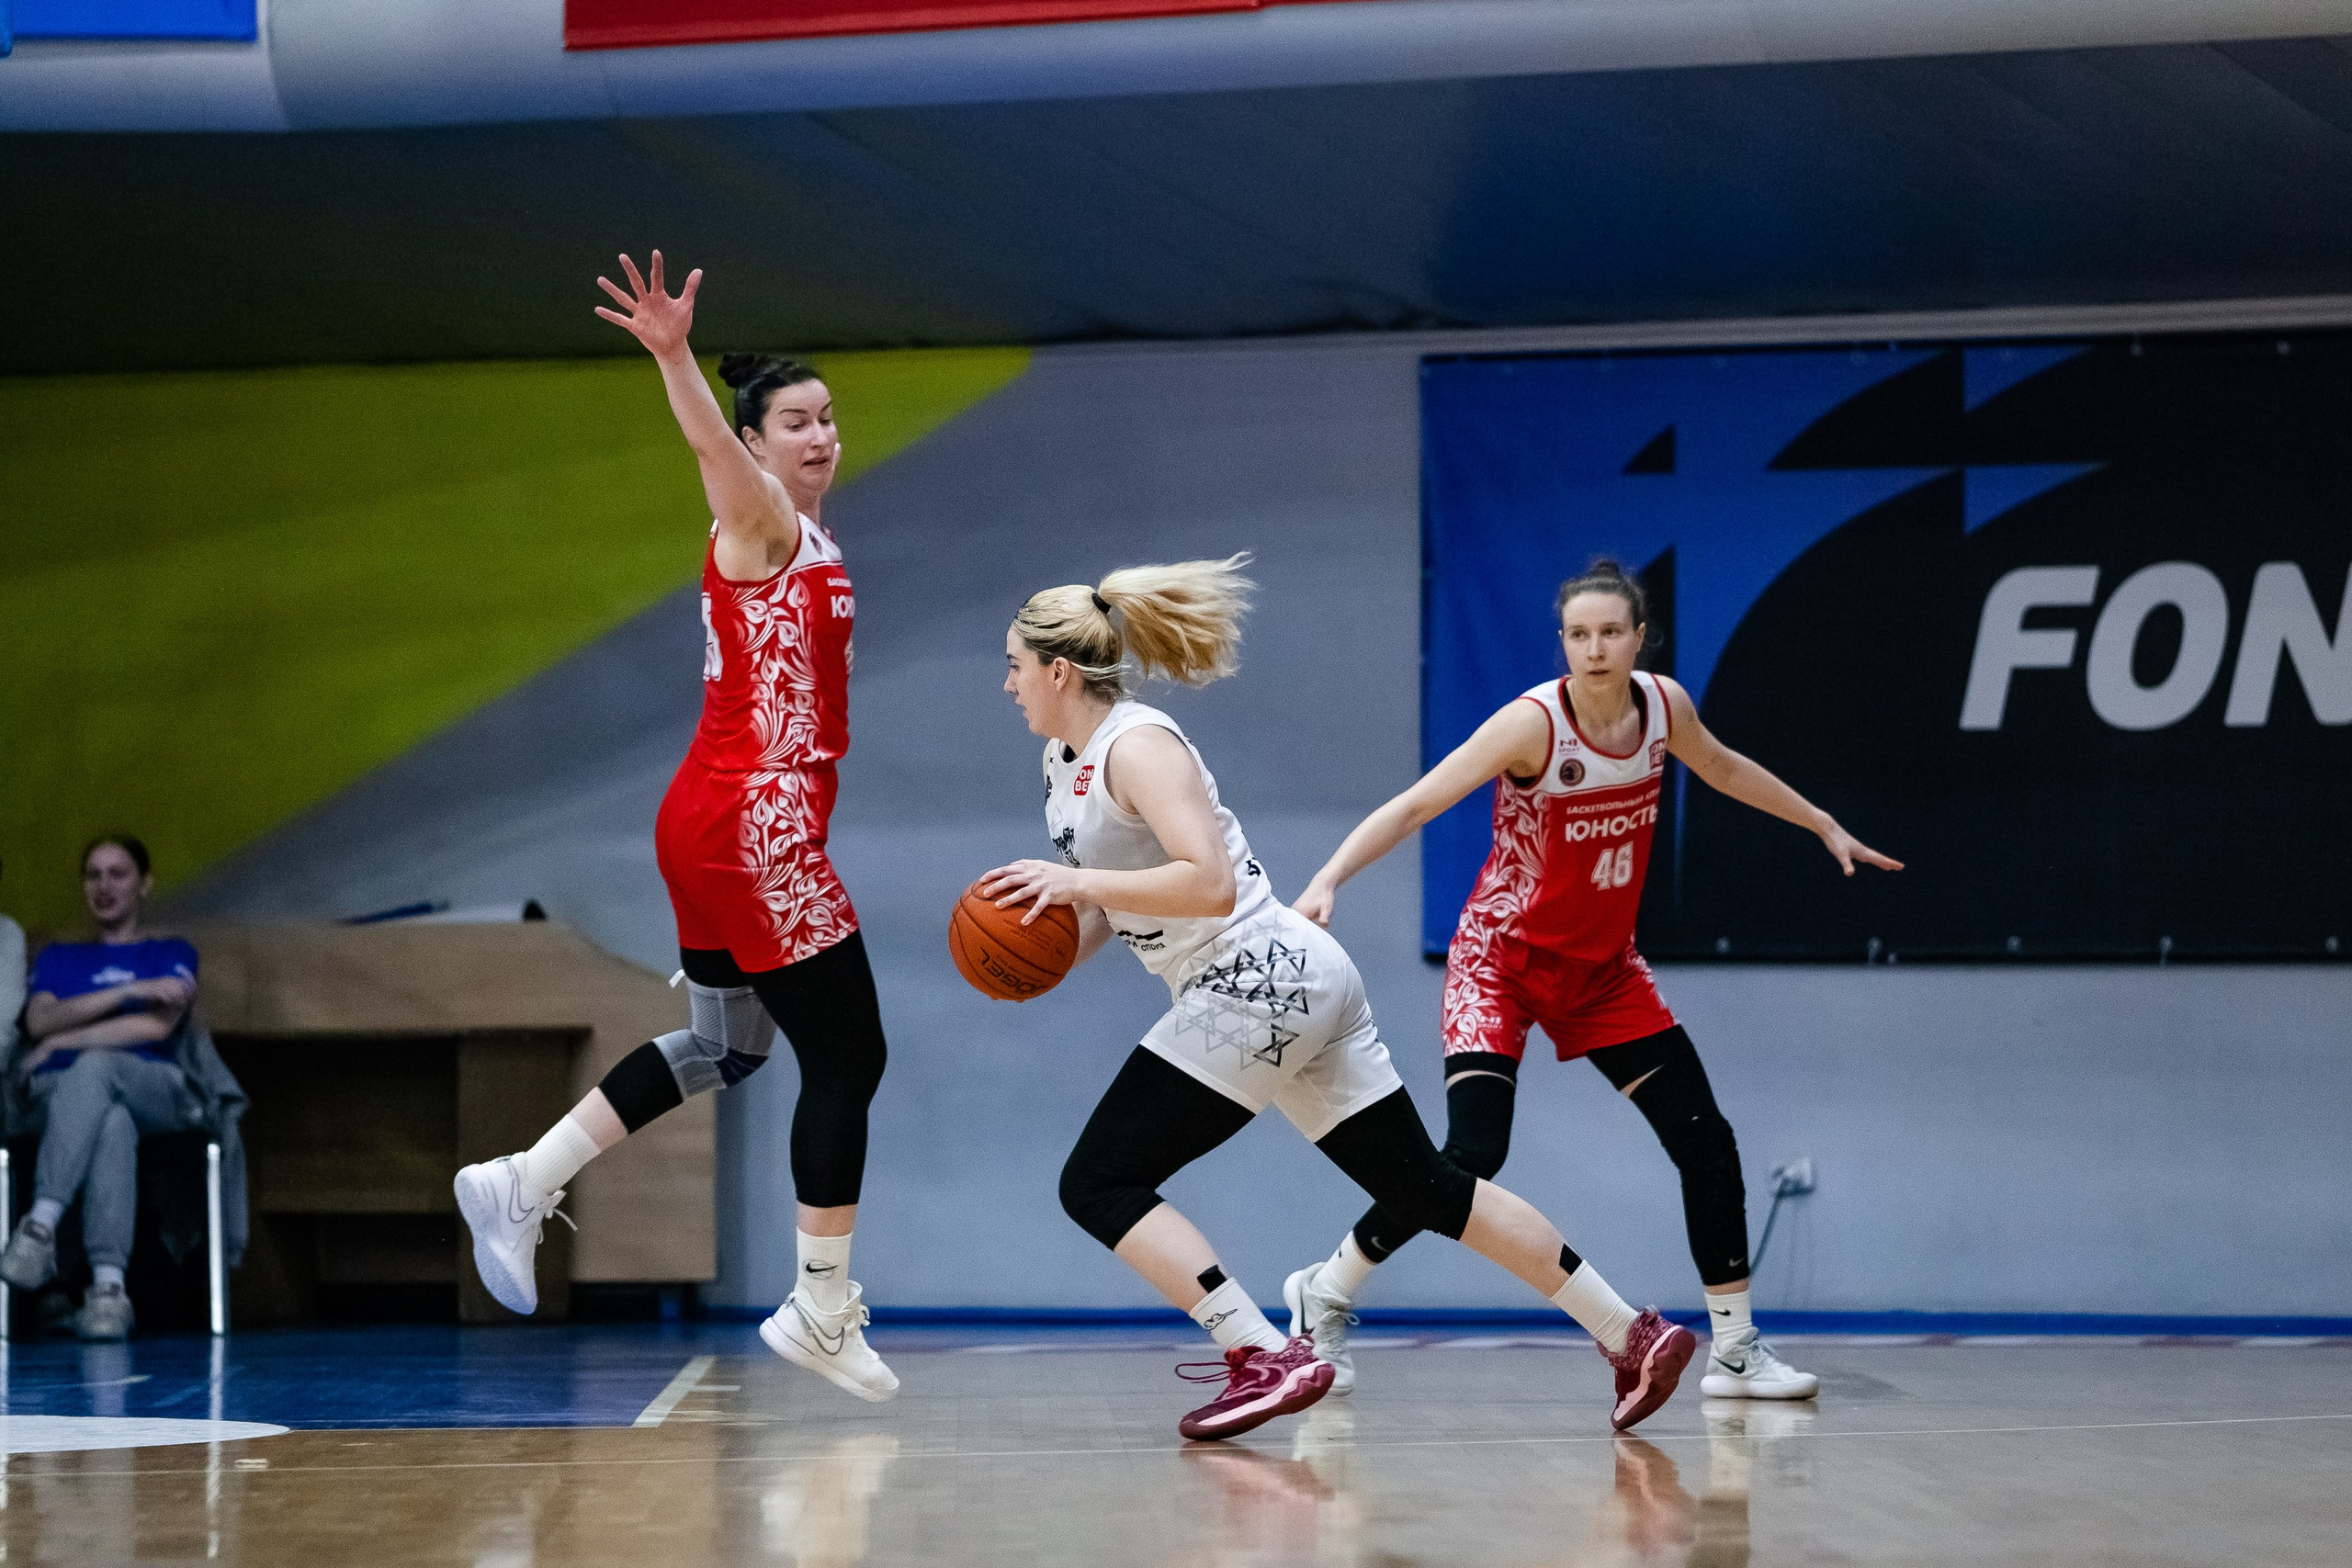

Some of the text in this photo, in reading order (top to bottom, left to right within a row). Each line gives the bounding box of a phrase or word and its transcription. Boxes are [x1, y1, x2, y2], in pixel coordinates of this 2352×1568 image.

[1958, 560, 2352, 732] FON
[1590, 840, 1634, 891] 46
[979, 946, 1050, 995] JOGEL
